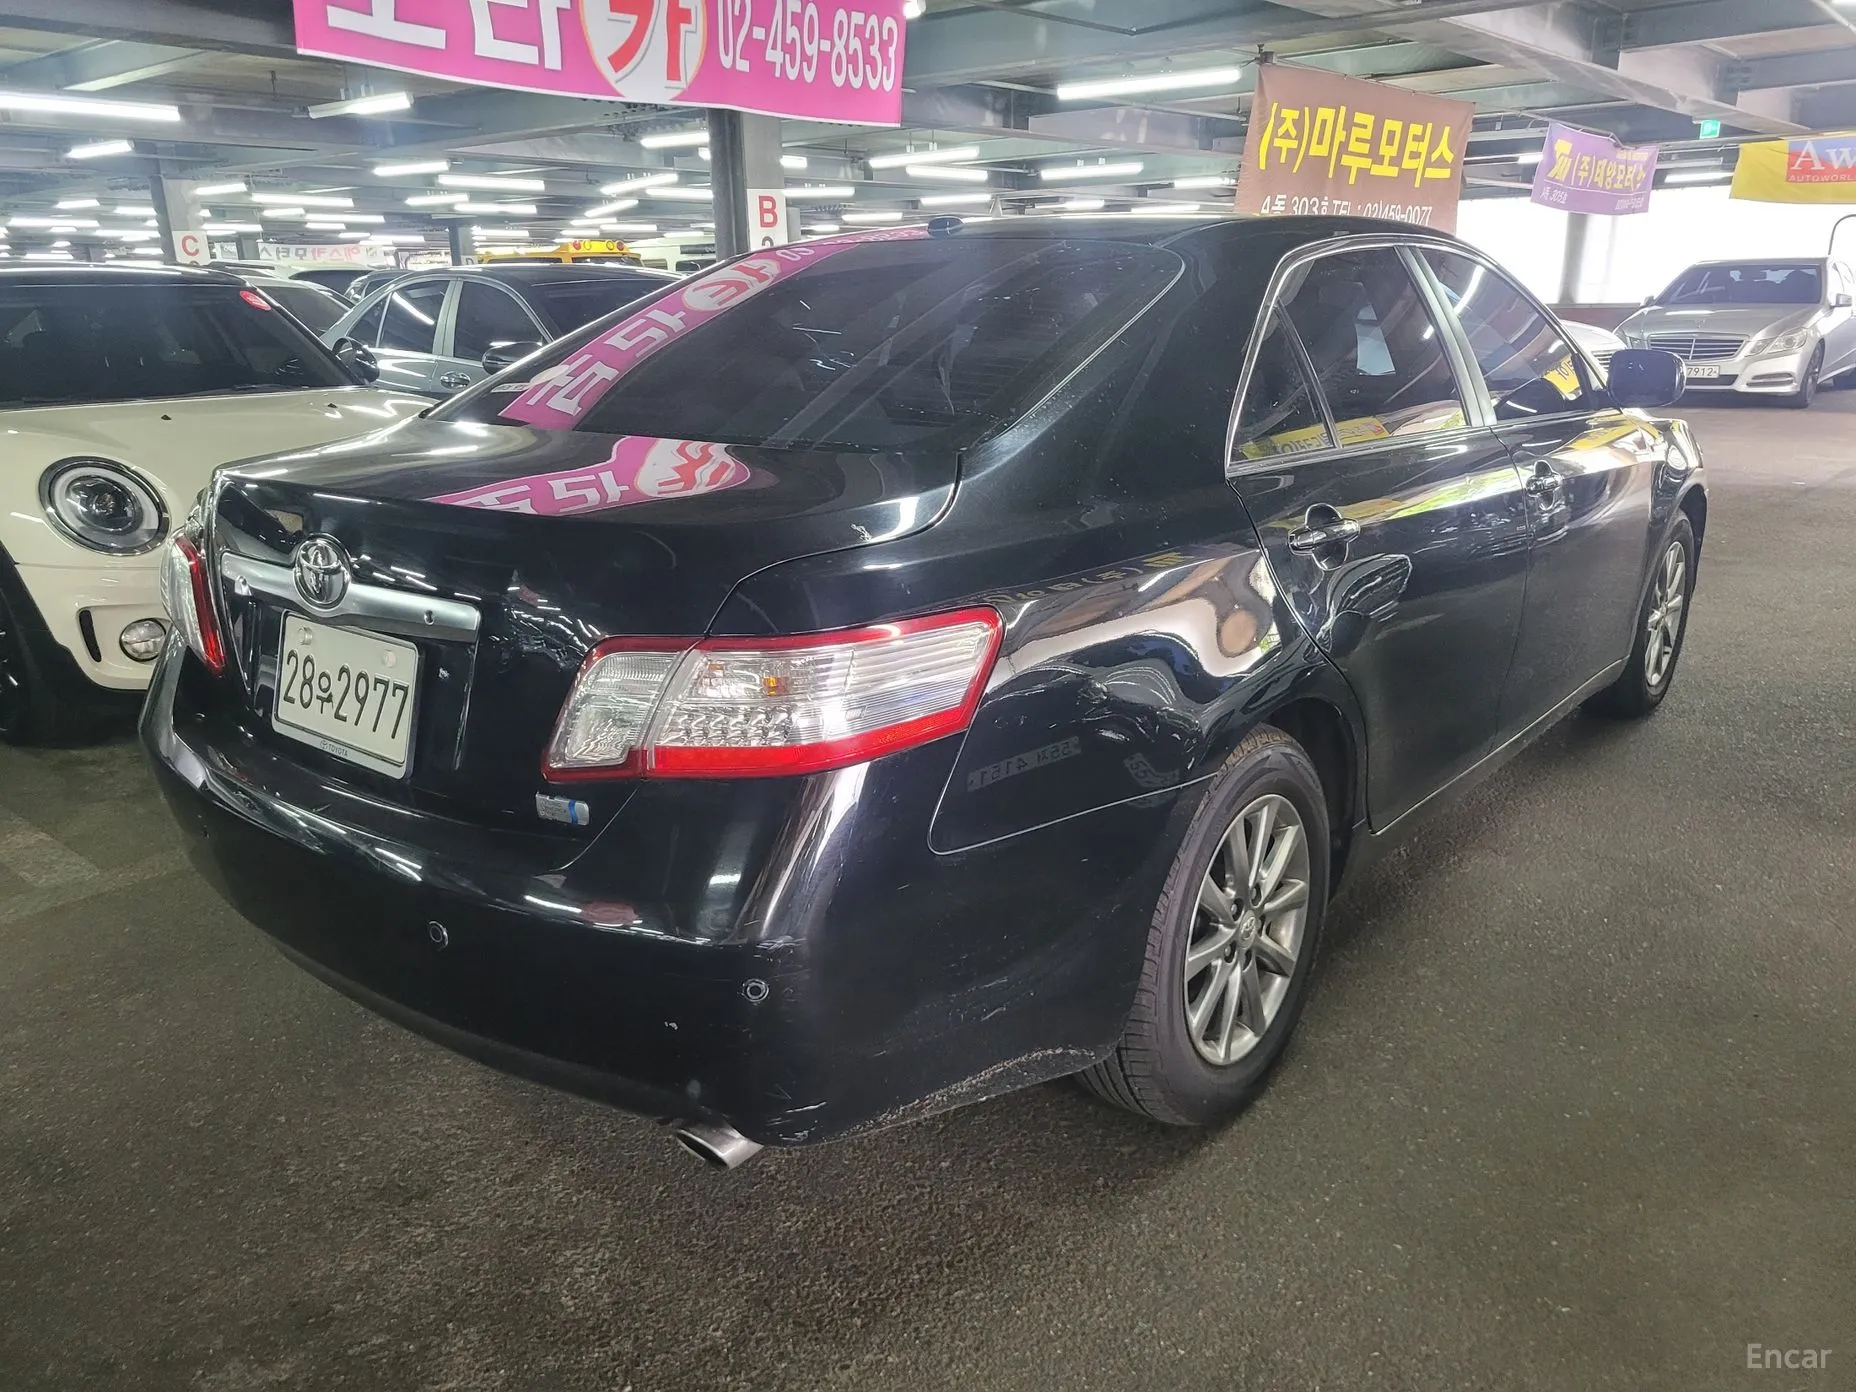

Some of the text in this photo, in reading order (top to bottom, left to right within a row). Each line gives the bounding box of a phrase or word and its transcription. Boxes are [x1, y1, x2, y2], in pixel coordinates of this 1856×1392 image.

[718, 0, 898, 92] 02-459-8533
[1259, 102, 1455, 188] (주)마루모터스
[759, 195, 778, 228] B
[181, 235, 200, 257] C
[1687, 367, 1713, 377] 7912
[282, 648, 409, 740] 28우2977
